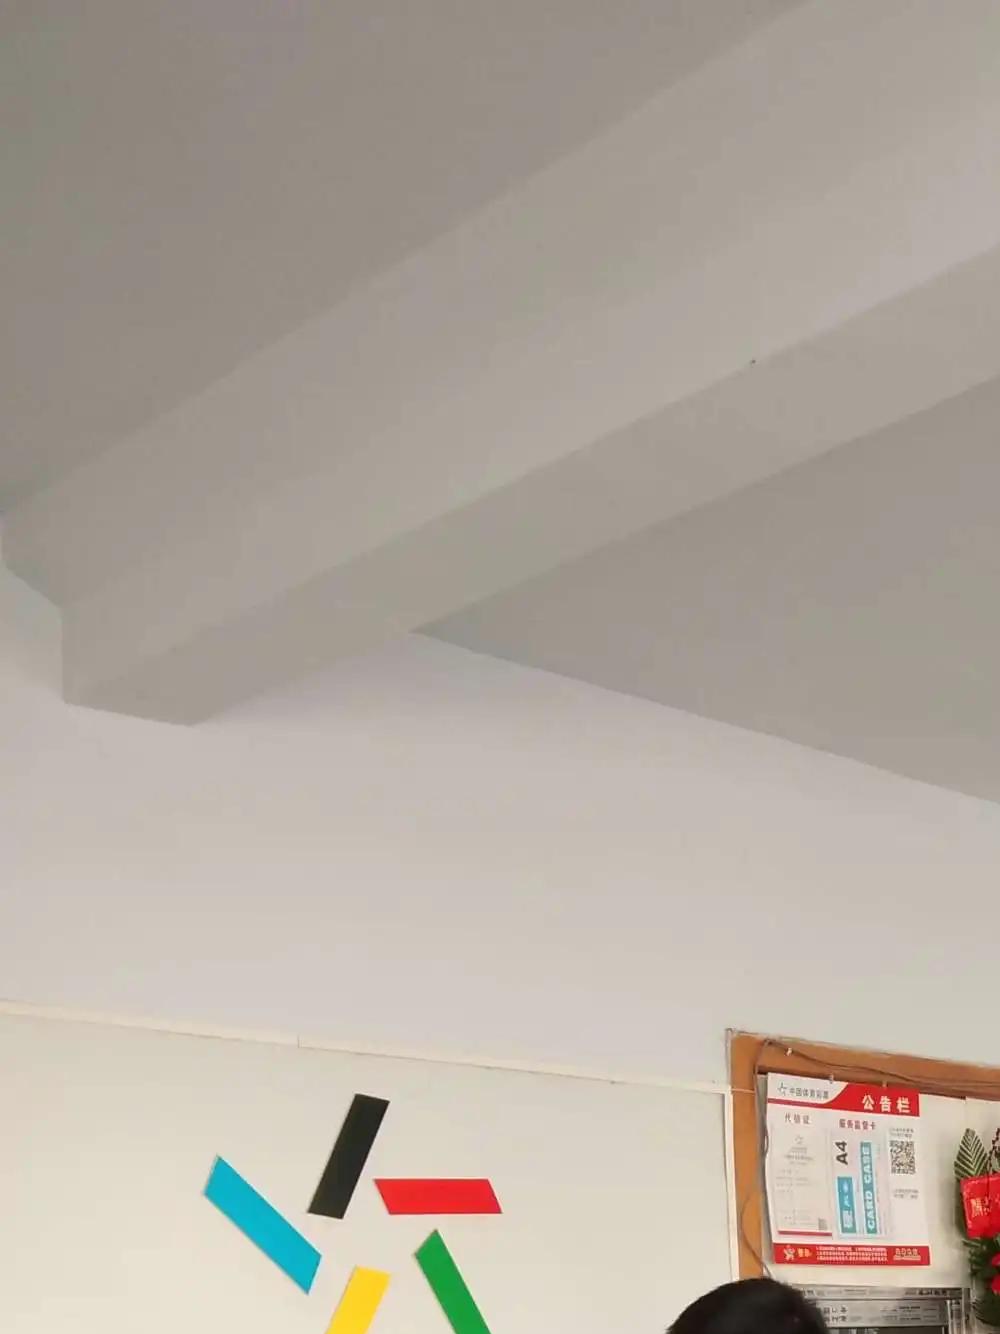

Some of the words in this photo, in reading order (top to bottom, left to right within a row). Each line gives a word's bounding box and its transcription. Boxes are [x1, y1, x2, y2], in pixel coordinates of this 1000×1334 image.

[861, 1094, 910, 1113] 公告栏
[835, 1141, 849, 1165] A4
